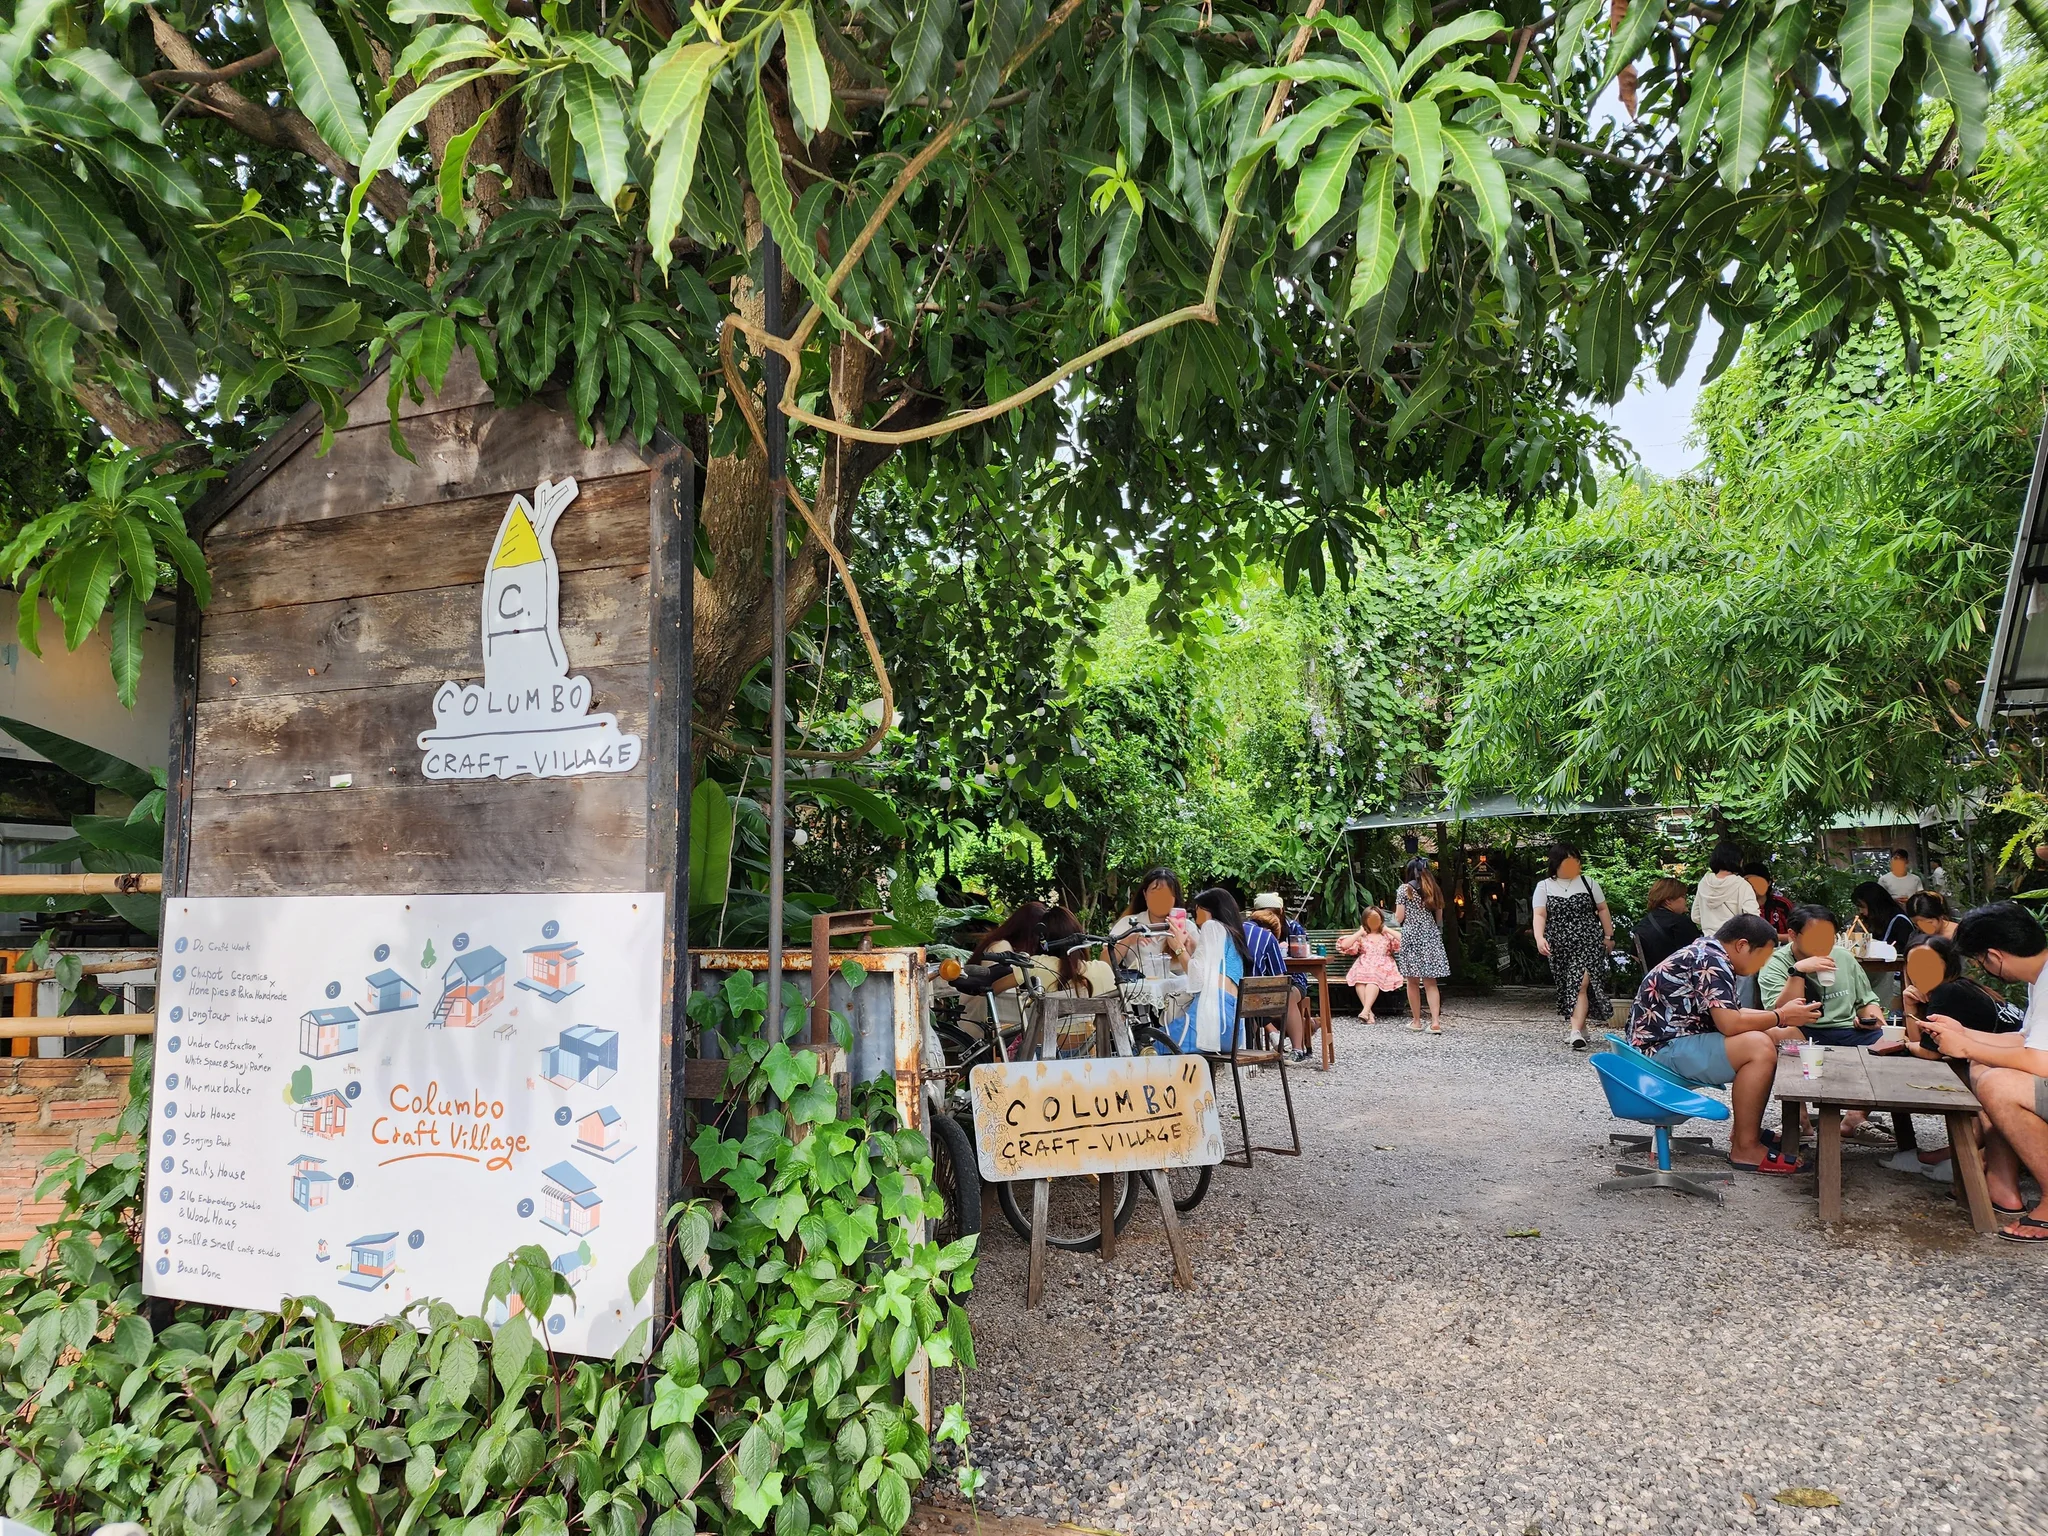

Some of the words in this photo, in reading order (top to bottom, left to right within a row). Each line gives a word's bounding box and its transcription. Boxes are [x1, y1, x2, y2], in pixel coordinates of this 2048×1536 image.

[499, 584, 531, 619] C.
[437, 685, 583, 717] COLUMBO
[193, 939, 204, 952] Do
[208, 942, 229, 951] Craft
[231, 970, 268, 982] Ceramics
[211, 986, 229, 1002] pies
[236, 1012, 248, 1022] ink
[250, 1014, 273, 1024] studio
[187, 1034, 211, 1049] Under
[214, 1039, 257, 1050] Construction
[185, 1055, 202, 1066] White
[204, 1058, 222, 1070] Space
[389, 1081, 504, 1119] Columbo
[184, 1103, 206, 1119] Jarb
[210, 1106, 236, 1120] House
[371, 1116, 440, 1146] Craft
[181, 1159, 214, 1179] Snail's
[217, 1162, 246, 1181] House
[179, 1190, 195, 1203] 216
[239, 1198, 261, 1210] studio
[186, 1207, 210, 1223] Wood
[212, 1209, 237, 1229] Haus
[257, 1247, 281, 1258] studio
